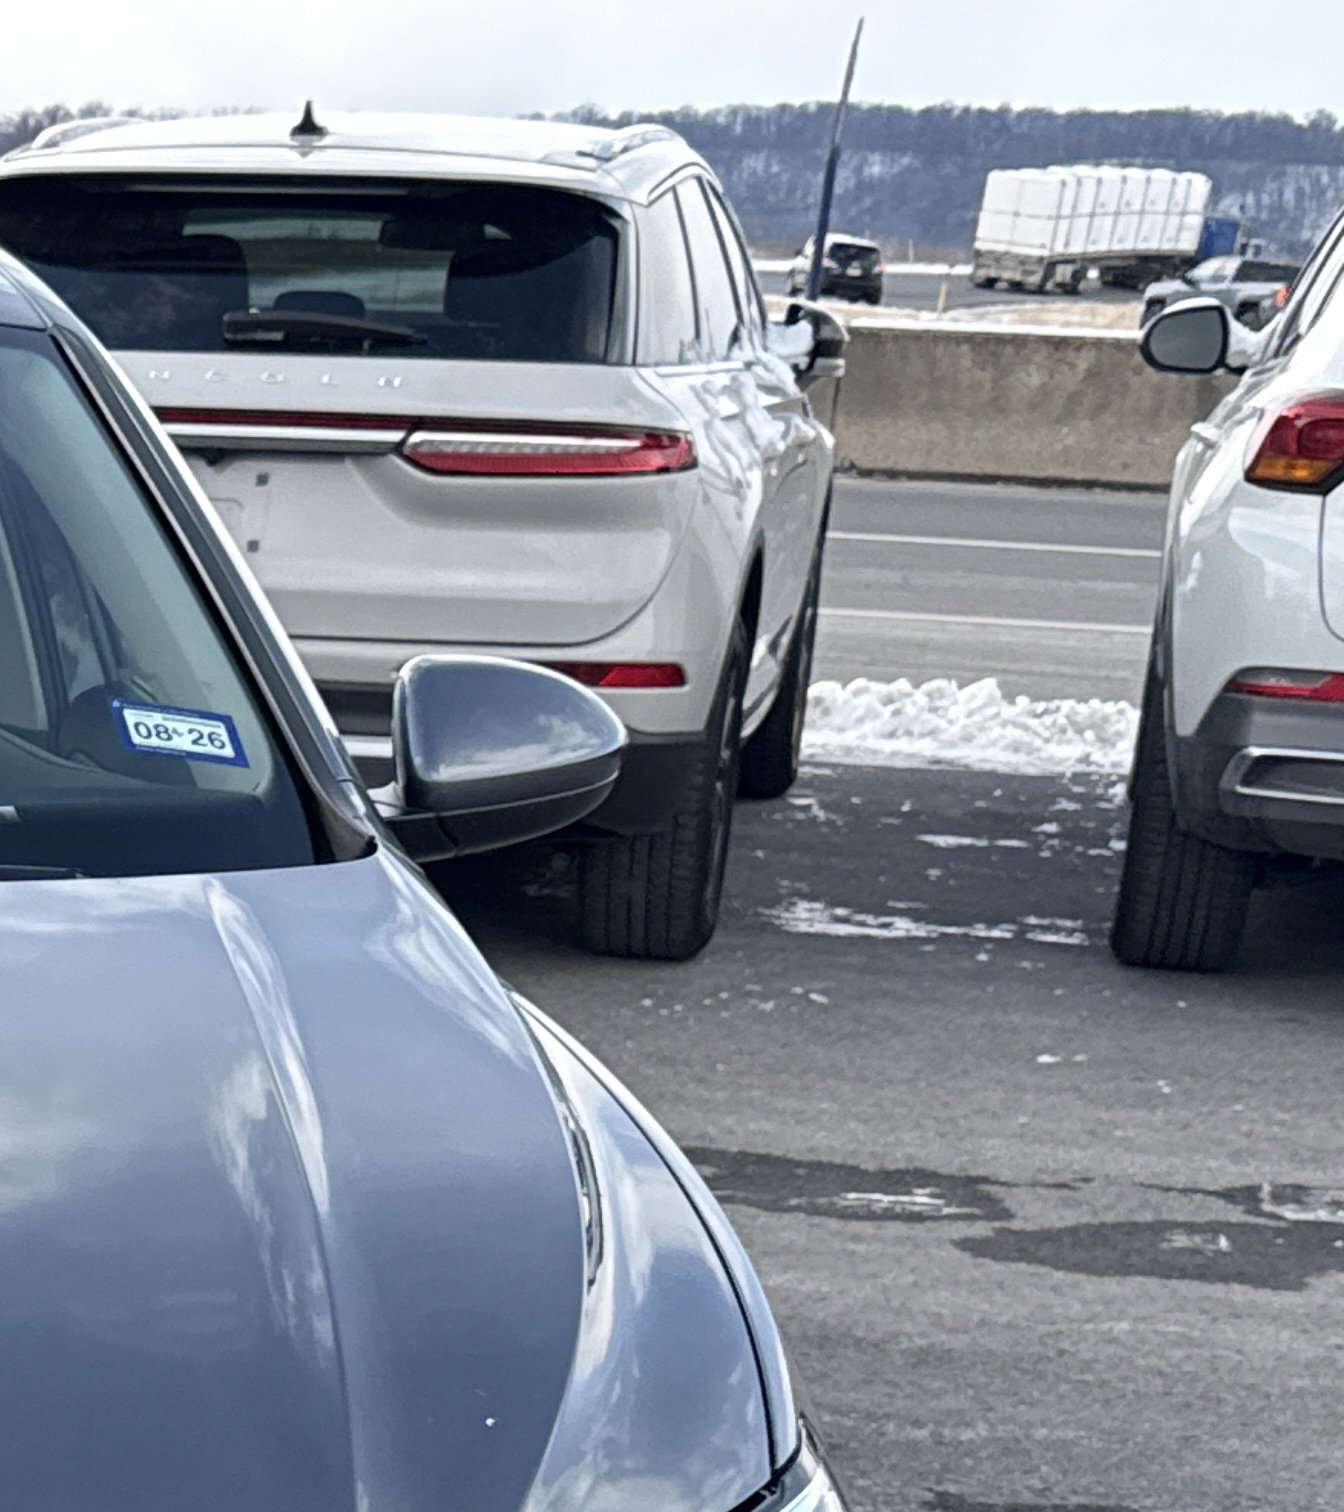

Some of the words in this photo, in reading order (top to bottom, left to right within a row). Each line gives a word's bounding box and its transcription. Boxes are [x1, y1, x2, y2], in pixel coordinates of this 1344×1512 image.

[148, 367, 403, 388] NCOLN
[133, 721, 174, 742] 08
[187, 727, 226, 750] 26
